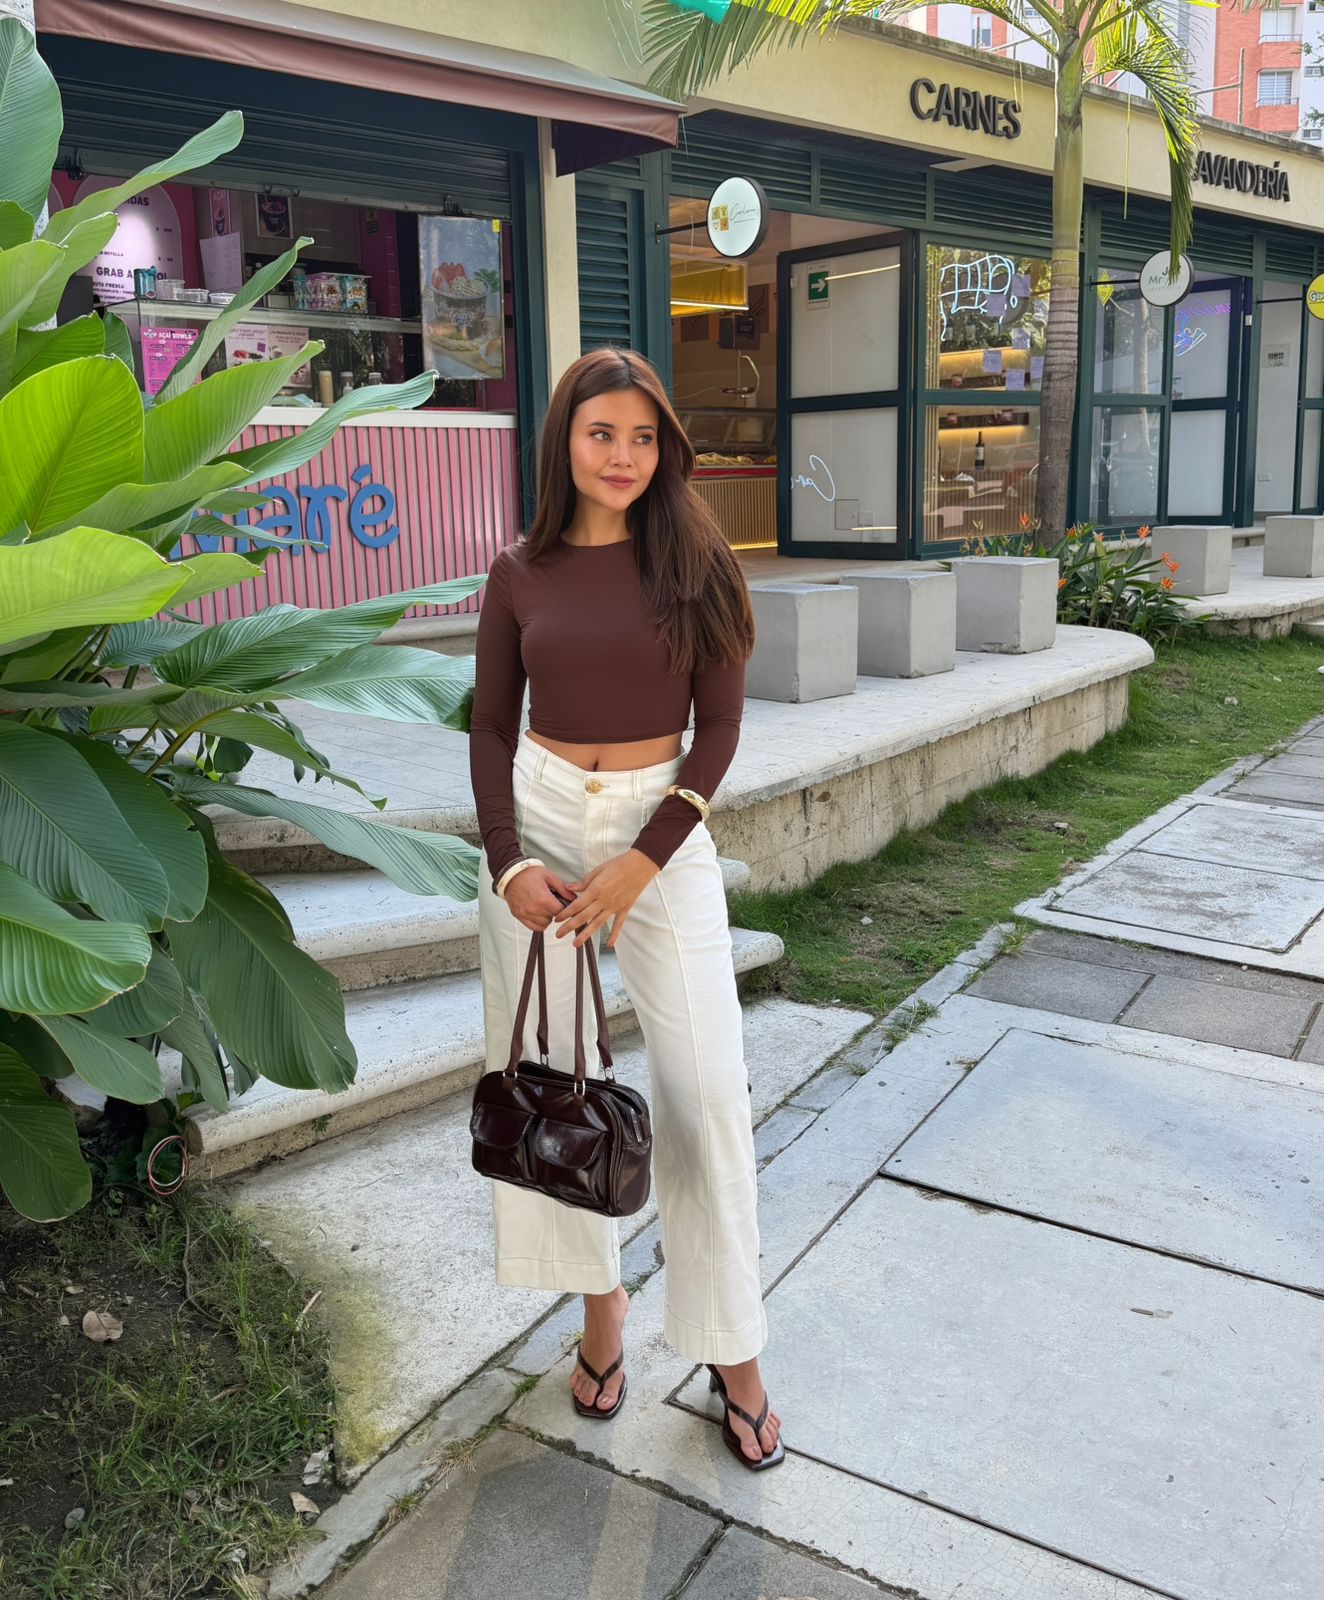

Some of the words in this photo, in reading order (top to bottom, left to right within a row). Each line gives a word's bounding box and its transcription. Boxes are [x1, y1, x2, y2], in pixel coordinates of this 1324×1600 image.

[909, 77, 1022, 139] CARNES
[1193, 150, 1290, 202] AVANDERÍA
[96, 266, 123, 278] GRAB
